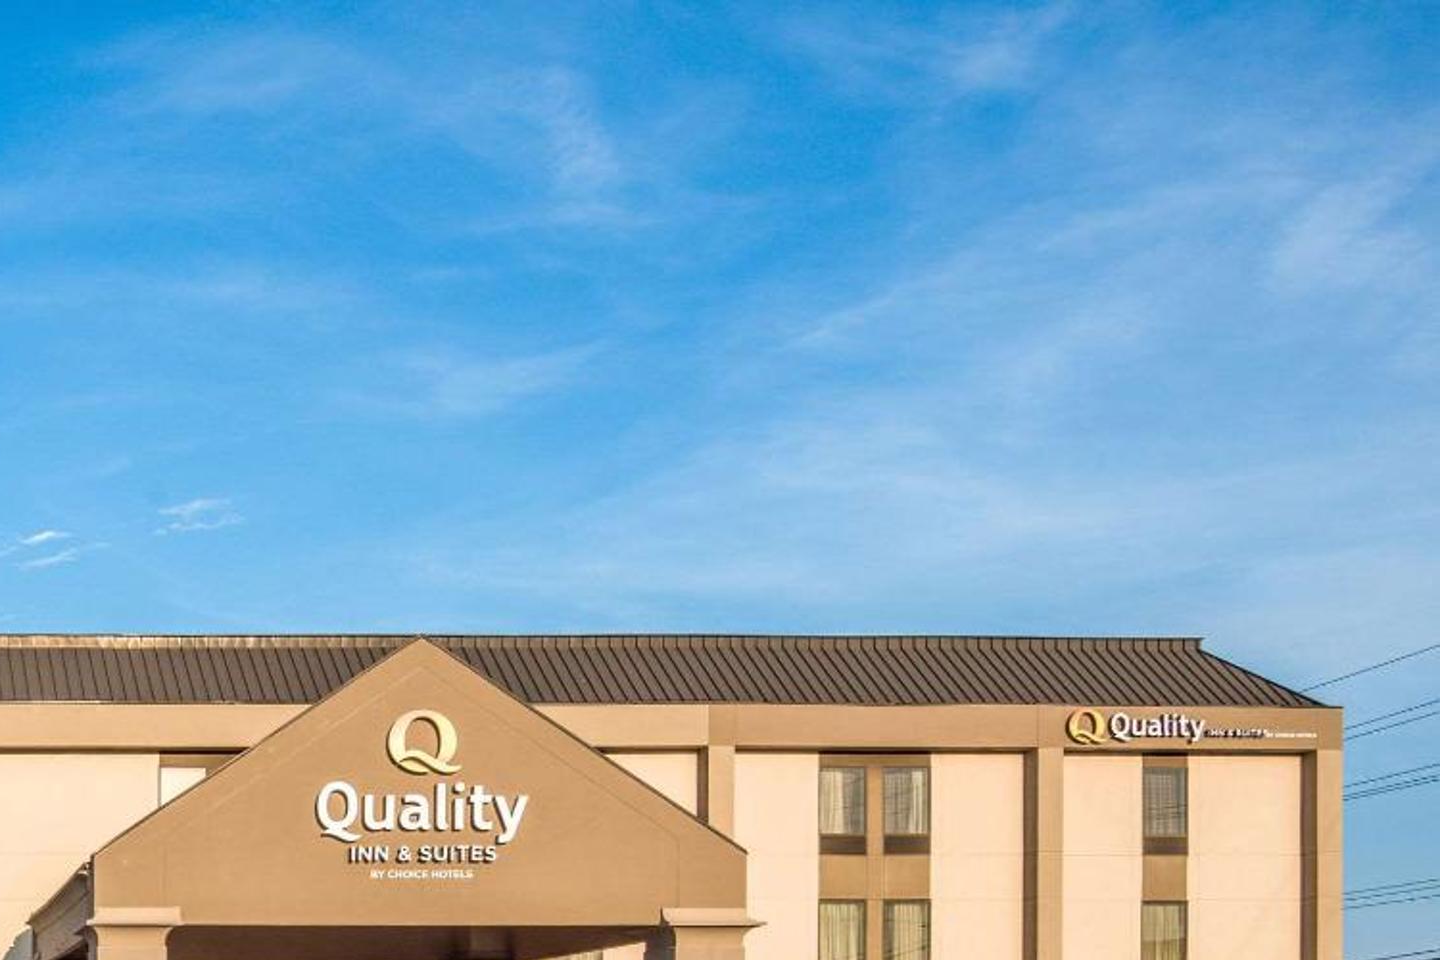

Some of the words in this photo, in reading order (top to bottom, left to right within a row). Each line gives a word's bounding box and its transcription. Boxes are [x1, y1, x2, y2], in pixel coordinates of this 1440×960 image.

[387, 709, 462, 775] Q
[1068, 708, 1107, 743] Q
[1110, 711, 1205, 742] Quality
[316, 780, 529, 842] Quality
[350, 846, 389, 862] INN
[398, 846, 412, 862] &
[419, 845, 497, 862] SUITES
[370, 869, 385, 879] BY
[387, 869, 428, 879] CHOICE
[431, 869, 474, 879] HOTELS
